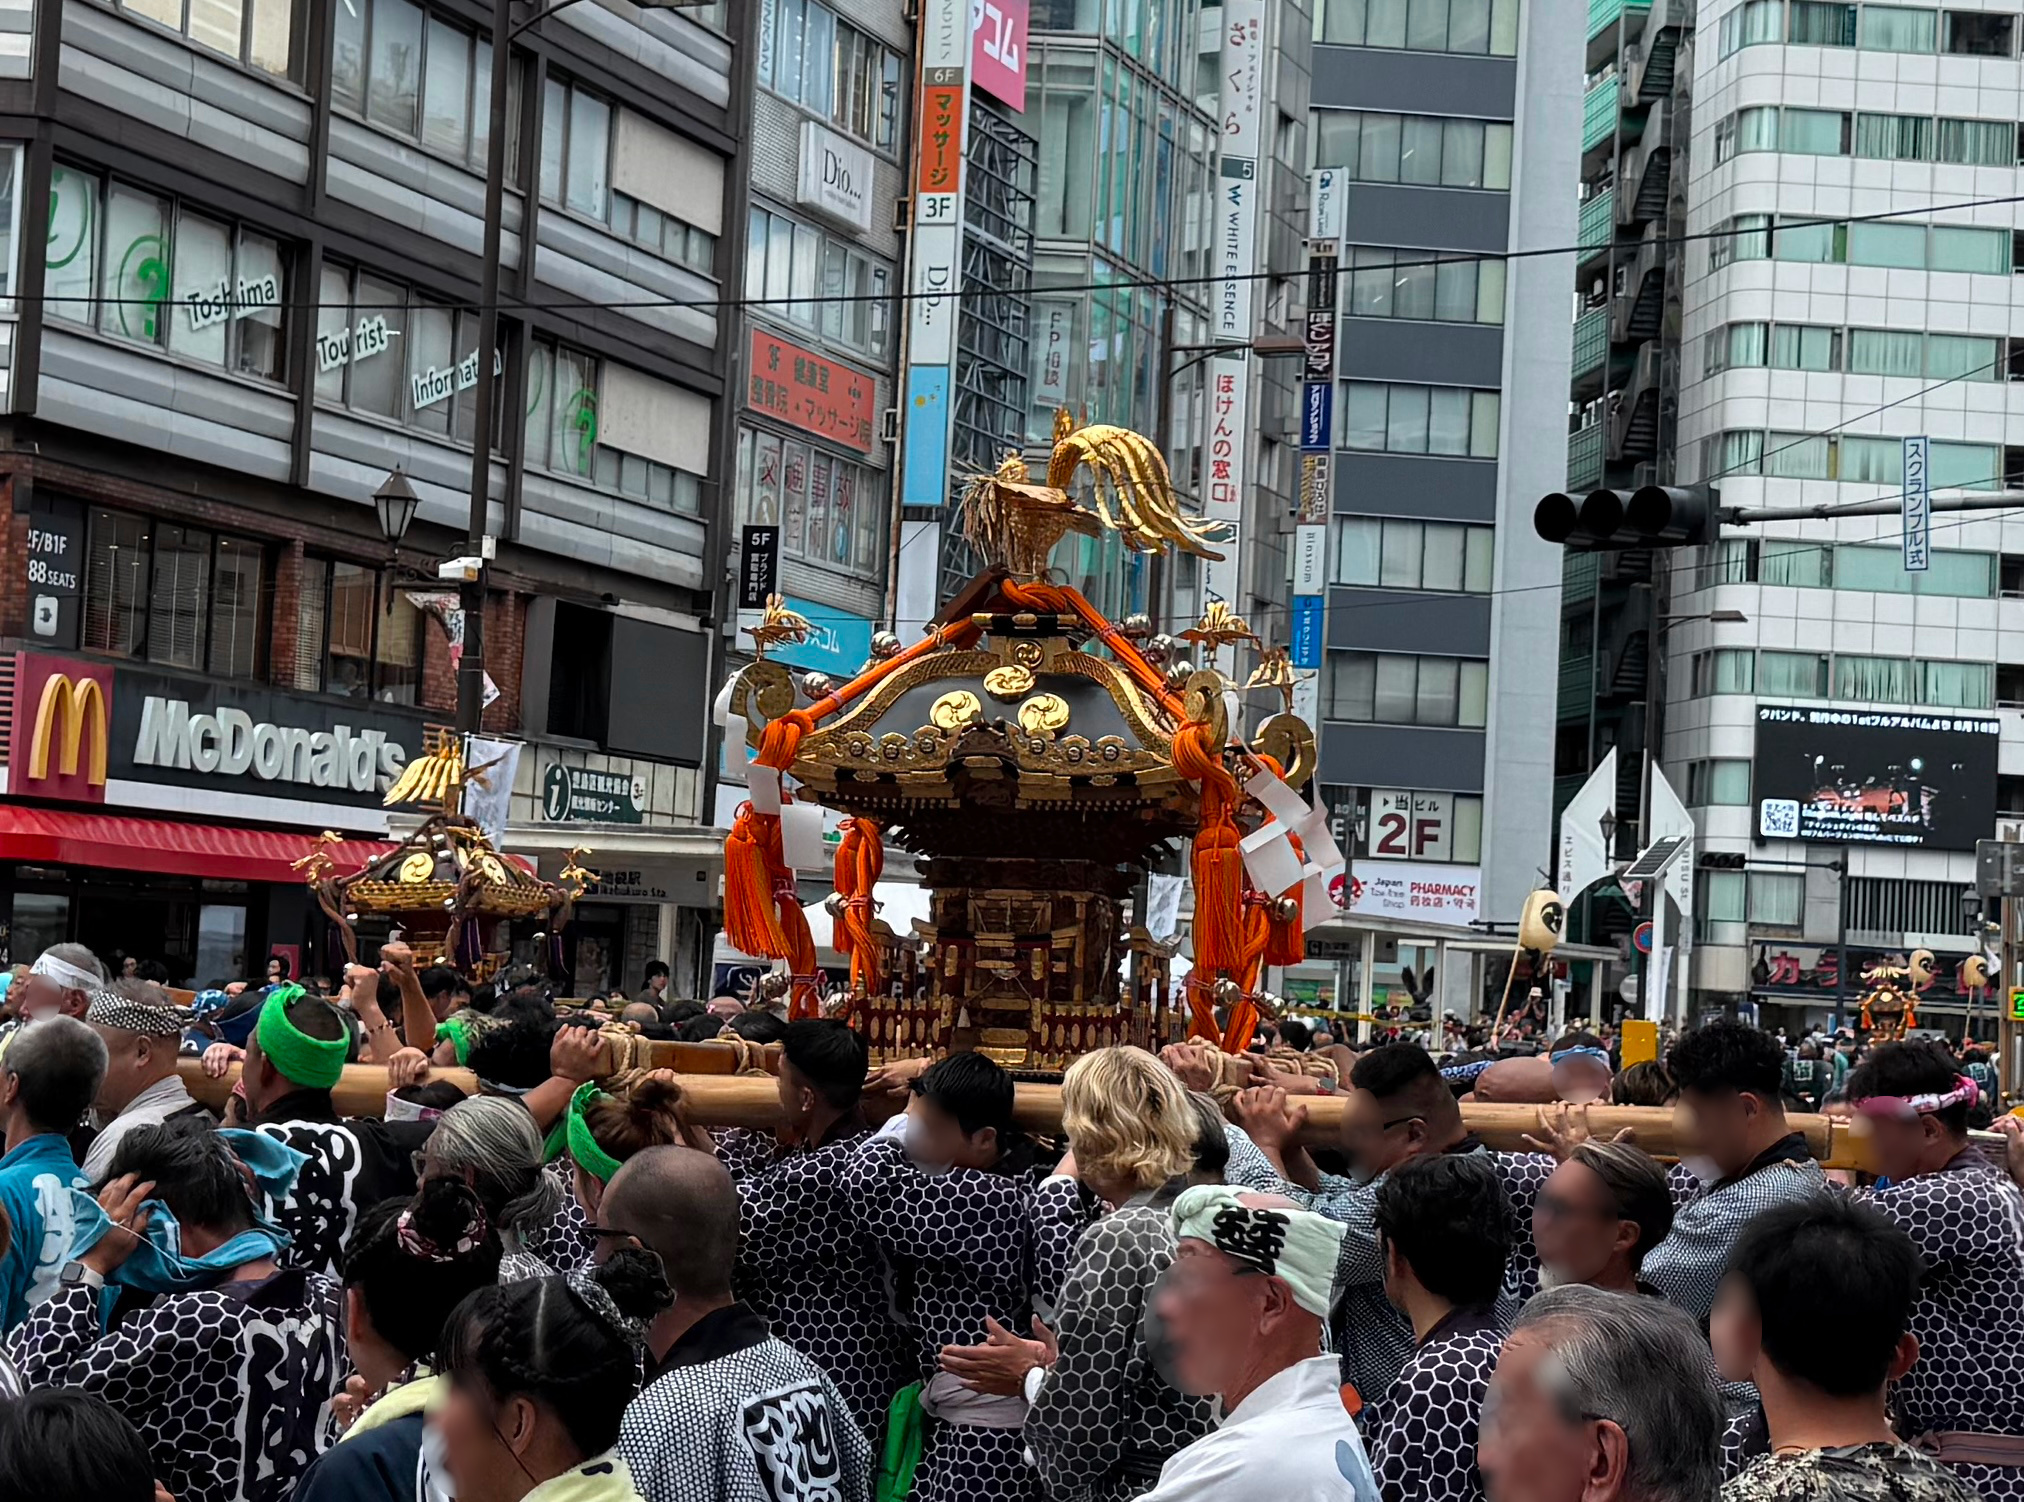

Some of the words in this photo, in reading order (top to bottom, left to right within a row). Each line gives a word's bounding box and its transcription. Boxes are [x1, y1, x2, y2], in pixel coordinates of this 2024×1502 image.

[934, 69, 955, 83] 6F
[1225, 22, 1246, 135] さくら
[930, 93, 952, 186] マッサージ
[823, 148, 861, 199] Dio...
[1242, 163, 1252, 179] 5
[925, 197, 951, 218] 3F
[1226, 212, 1240, 260] WHITE
[318, 321, 385, 365] Tourist
[1212, 374, 1235, 503] ほけんの窓口
[759, 445, 851, 511] 交通事故
[751, 532, 771, 546] 5F
[47, 570, 76, 589] SEATS
[759, 553, 769, 591] ブランド
[133, 696, 406, 792] McDonald's
[1334, 803, 1366, 816] ROM
[1395, 794, 1440, 812] 当ビル
[1376, 813, 1442, 856] 2F
[1374, 877, 1404, 888] Japan
[1410, 881, 1476, 898] PHARMACY
